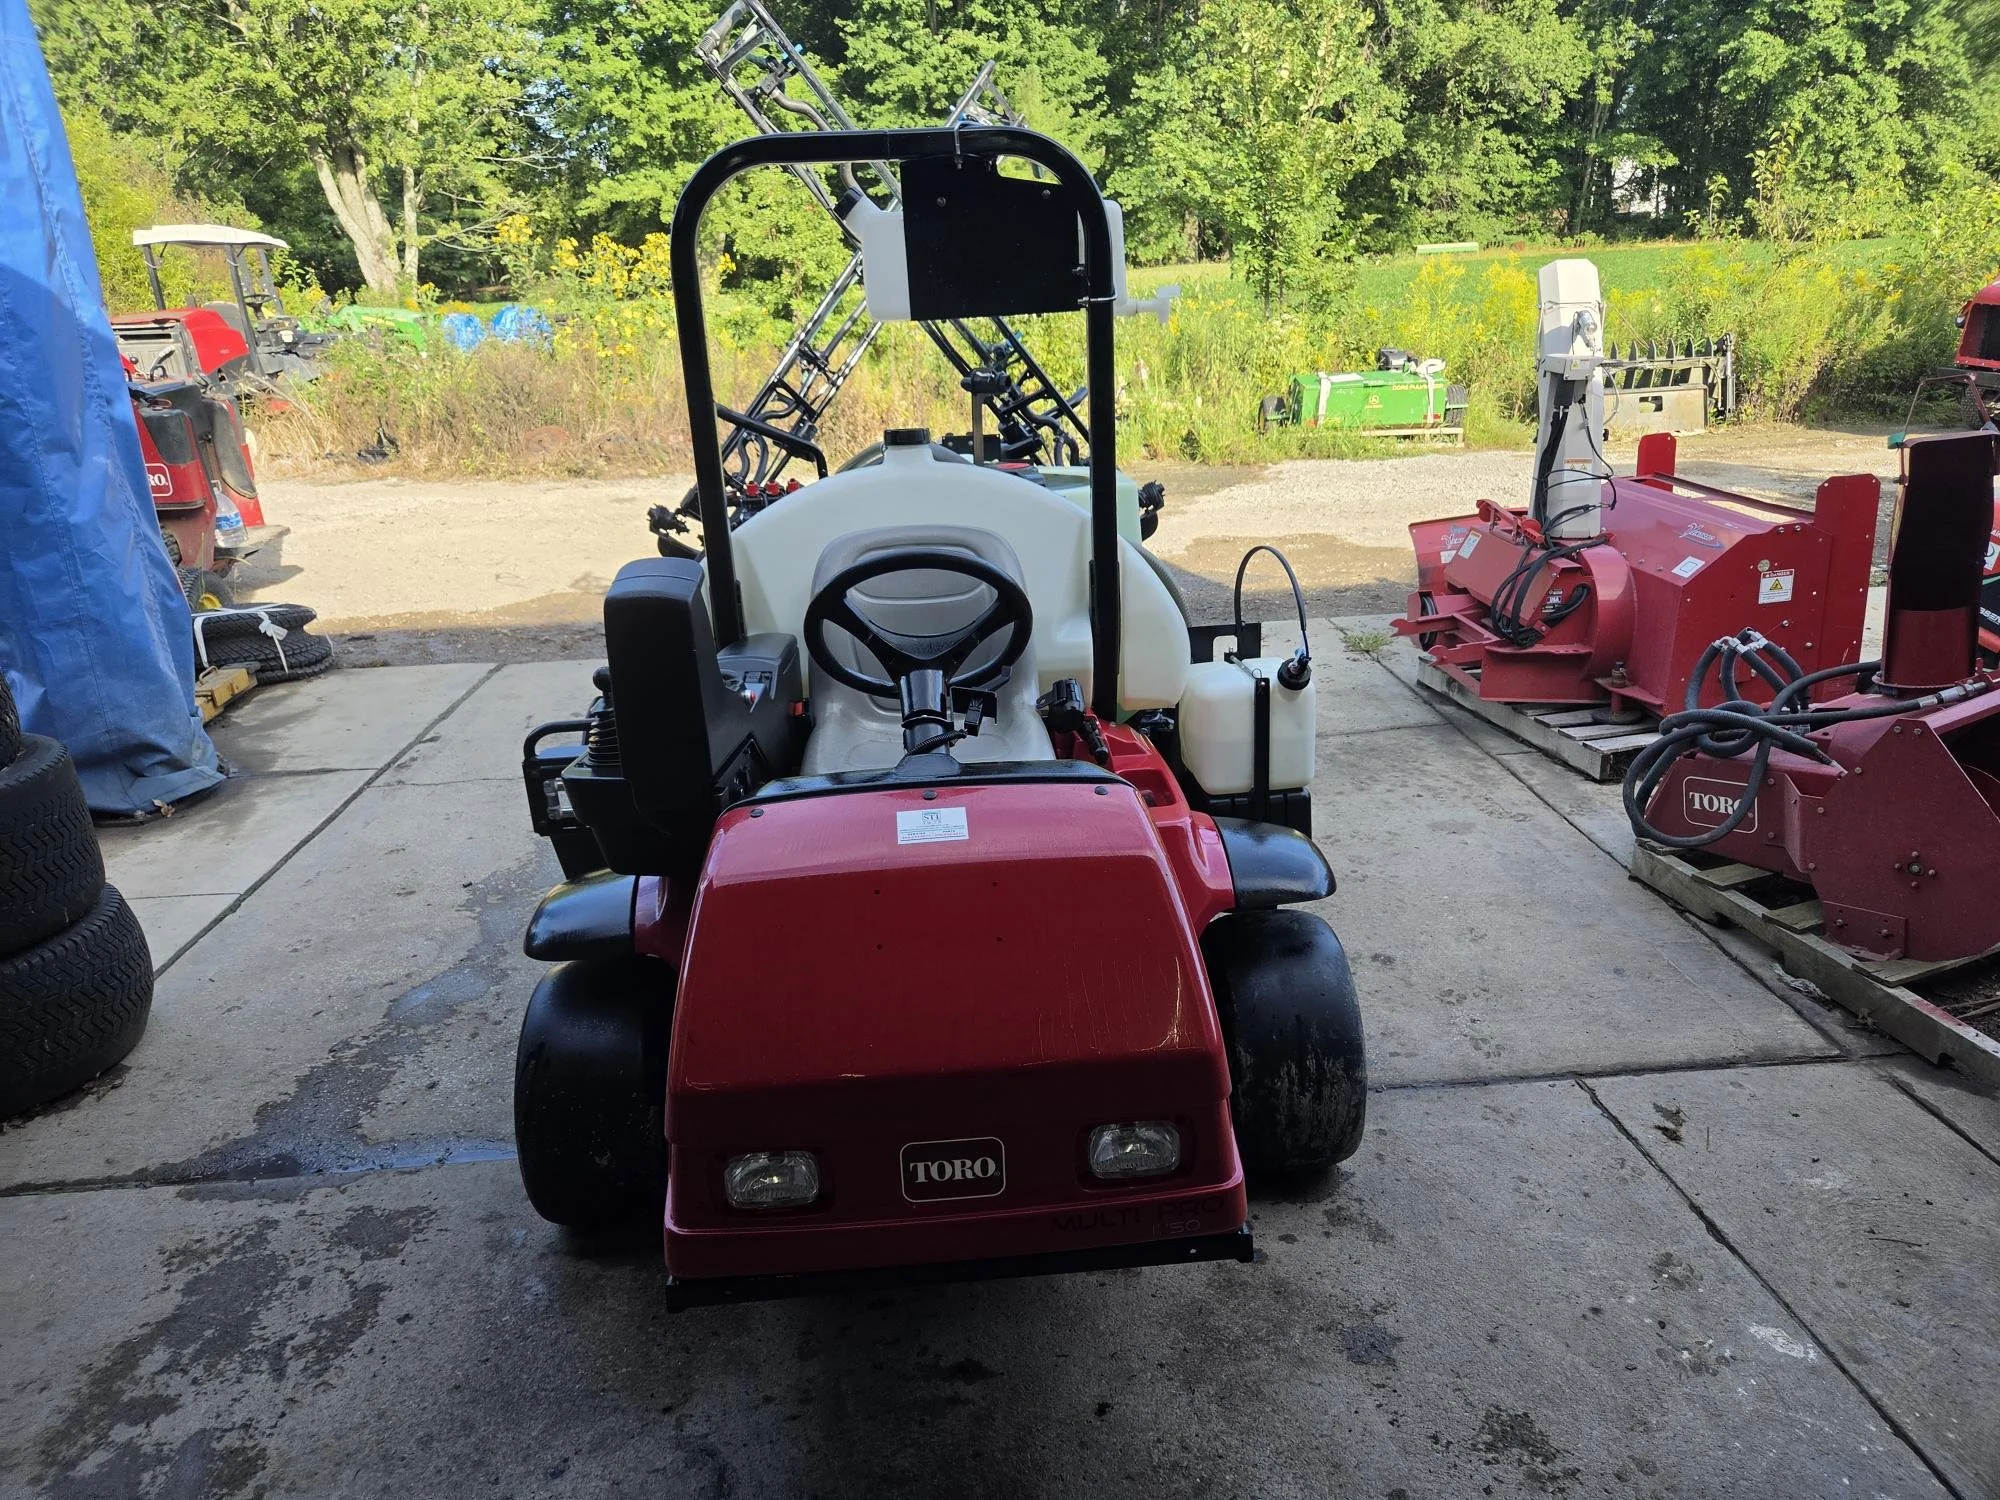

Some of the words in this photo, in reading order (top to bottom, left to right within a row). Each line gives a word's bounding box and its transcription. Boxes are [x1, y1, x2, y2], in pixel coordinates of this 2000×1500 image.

[147, 474, 166, 486] RO
[909, 1156, 996, 1183] TORO
[1051, 1206, 1141, 1233] MULTI
[1158, 1195, 1225, 1222] PRO
